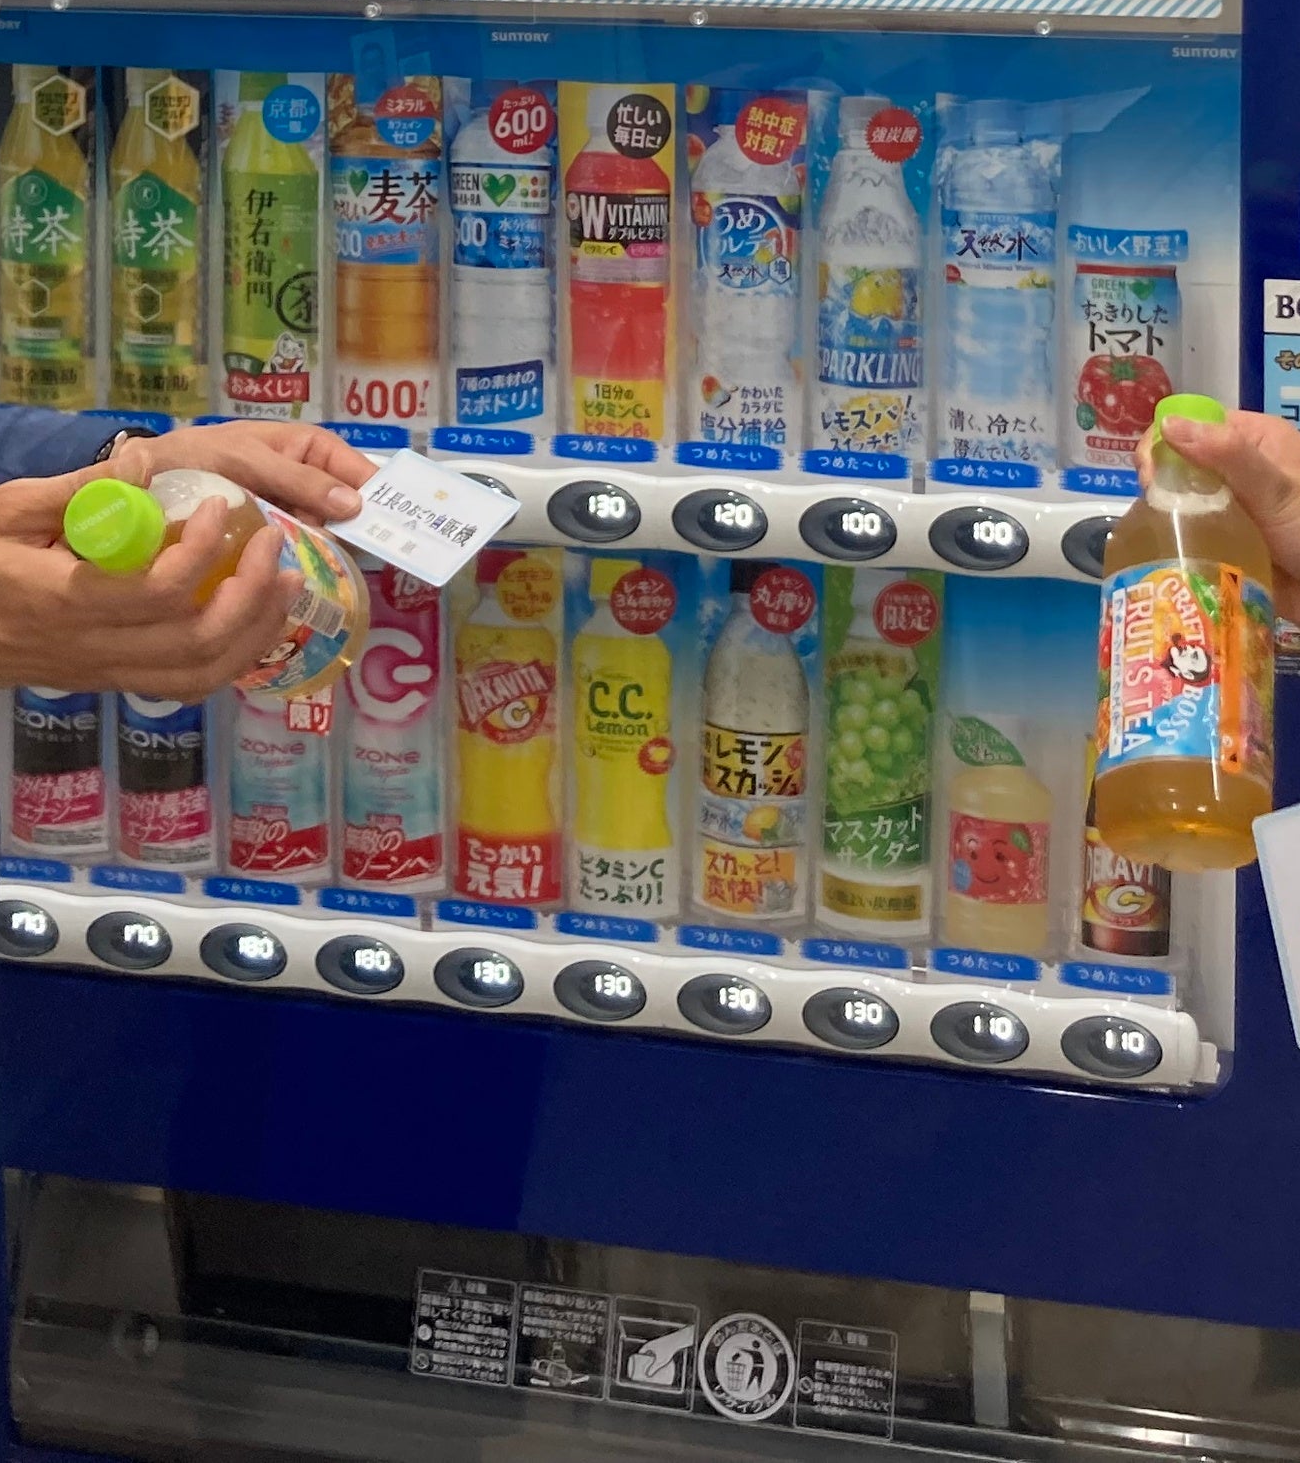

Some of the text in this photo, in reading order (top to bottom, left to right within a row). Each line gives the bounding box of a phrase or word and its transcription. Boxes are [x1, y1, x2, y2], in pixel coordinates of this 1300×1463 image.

[491, 31, 550, 43] SUNTORY
[1172, 47, 1238, 59] SUNTORY
[386, 100, 426, 113] ミネラル
[617, 103, 662, 125] 忙しい
[494, 105, 548, 139] 600
[747, 105, 798, 137] 熱中症
[392, 132, 418, 145] ゼロ
[614, 127, 662, 149] 毎日に!
[743, 129, 786, 159] 対策!
[871, 126, 919, 144] 強炭酸
[368, 169, 439, 225] 麦茶
[715, 205, 767, 235] うめ
[245, 188, 278, 307] 伊右衛門
[956, 229, 1039, 262] 天然水
[1075, 232, 1181, 256] おいしく野菜!
[1081, 299, 1169, 325] すっきりした
[1088, 321, 1164, 356] トマト
[593, 383, 635, 401] 1日分の
[740, 385, 785, 399] かわいた
[740, 401, 784, 414] カラダに
[700, 411, 787, 446] 塩分補給
[588, 494, 628, 519] 130
[712, 503, 754, 528] 120
[841, 512, 882, 535] 100
[972, 521, 1013, 545] 100
[881, 605, 933, 633] 限定
[1122, 581, 1155, 753] FRUITS TEA
[1155, 577, 1206, 746] CRAFT BOSS
[588, 681, 653, 719] C.C.
[586, 717, 649, 737] Lemon
[716, 734, 784, 766] レモン
[715, 765, 800, 797] スカッシュ
[825, 805, 923, 844] マスカット
[579, 855, 666, 881] ビタミンC
[836, 841, 920, 870] サイダー
[465, 864, 543, 900] 元気!
[578, 876, 665, 907] たっぷり!
[594, 973, 632, 998] 130
[719, 986, 756, 1011] 130
[843, 999, 883, 1024] 130
